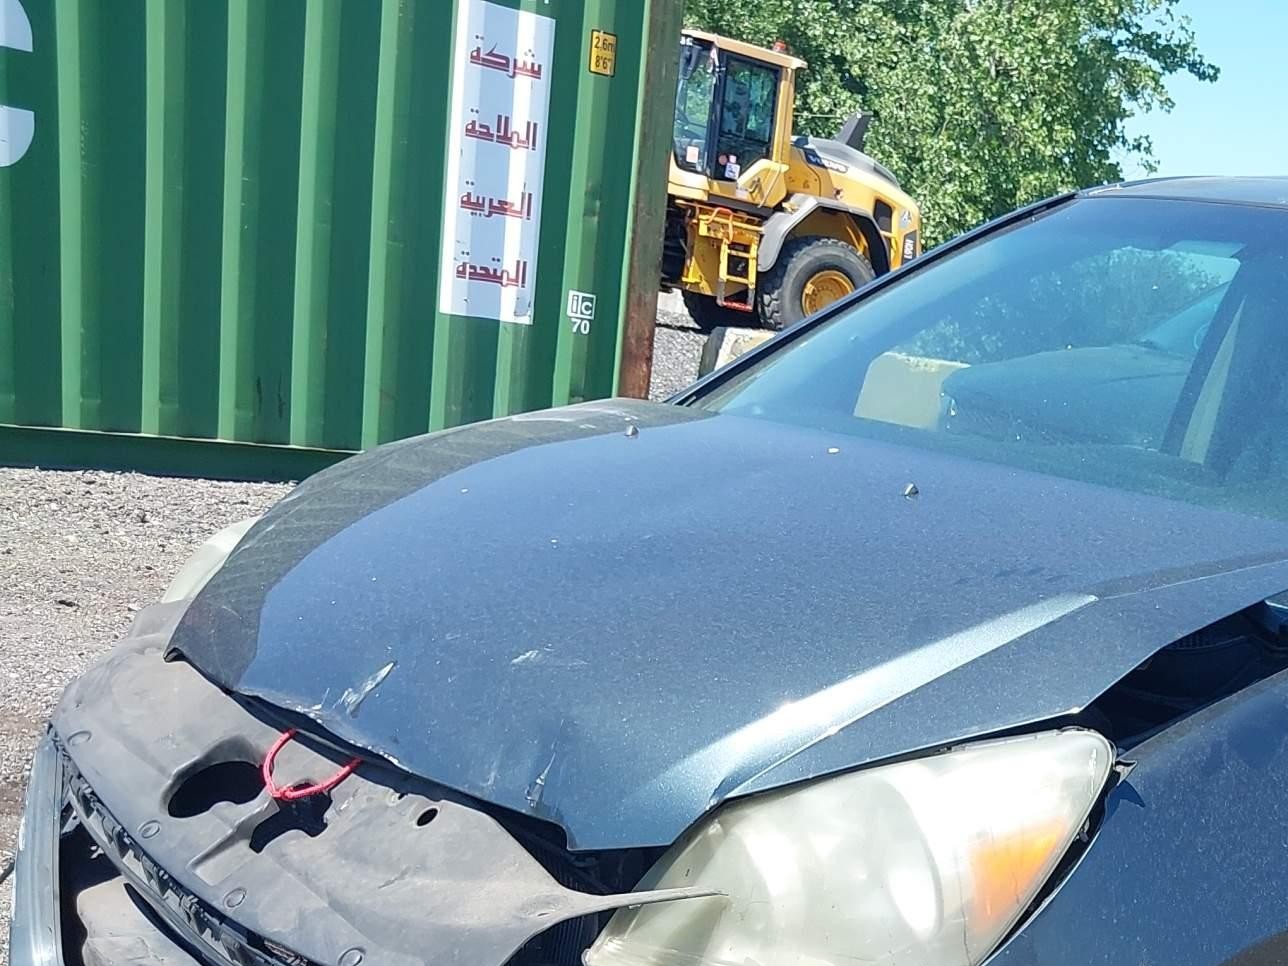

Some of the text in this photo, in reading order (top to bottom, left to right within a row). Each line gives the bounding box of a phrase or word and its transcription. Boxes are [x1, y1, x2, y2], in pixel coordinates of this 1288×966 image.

[469, 34, 542, 80] شركة
[465, 107, 537, 151] الملاحة
[460, 180, 532, 221] العربية
[456, 250, 527, 288] المتحدة
[571, 317, 590, 335] 70
